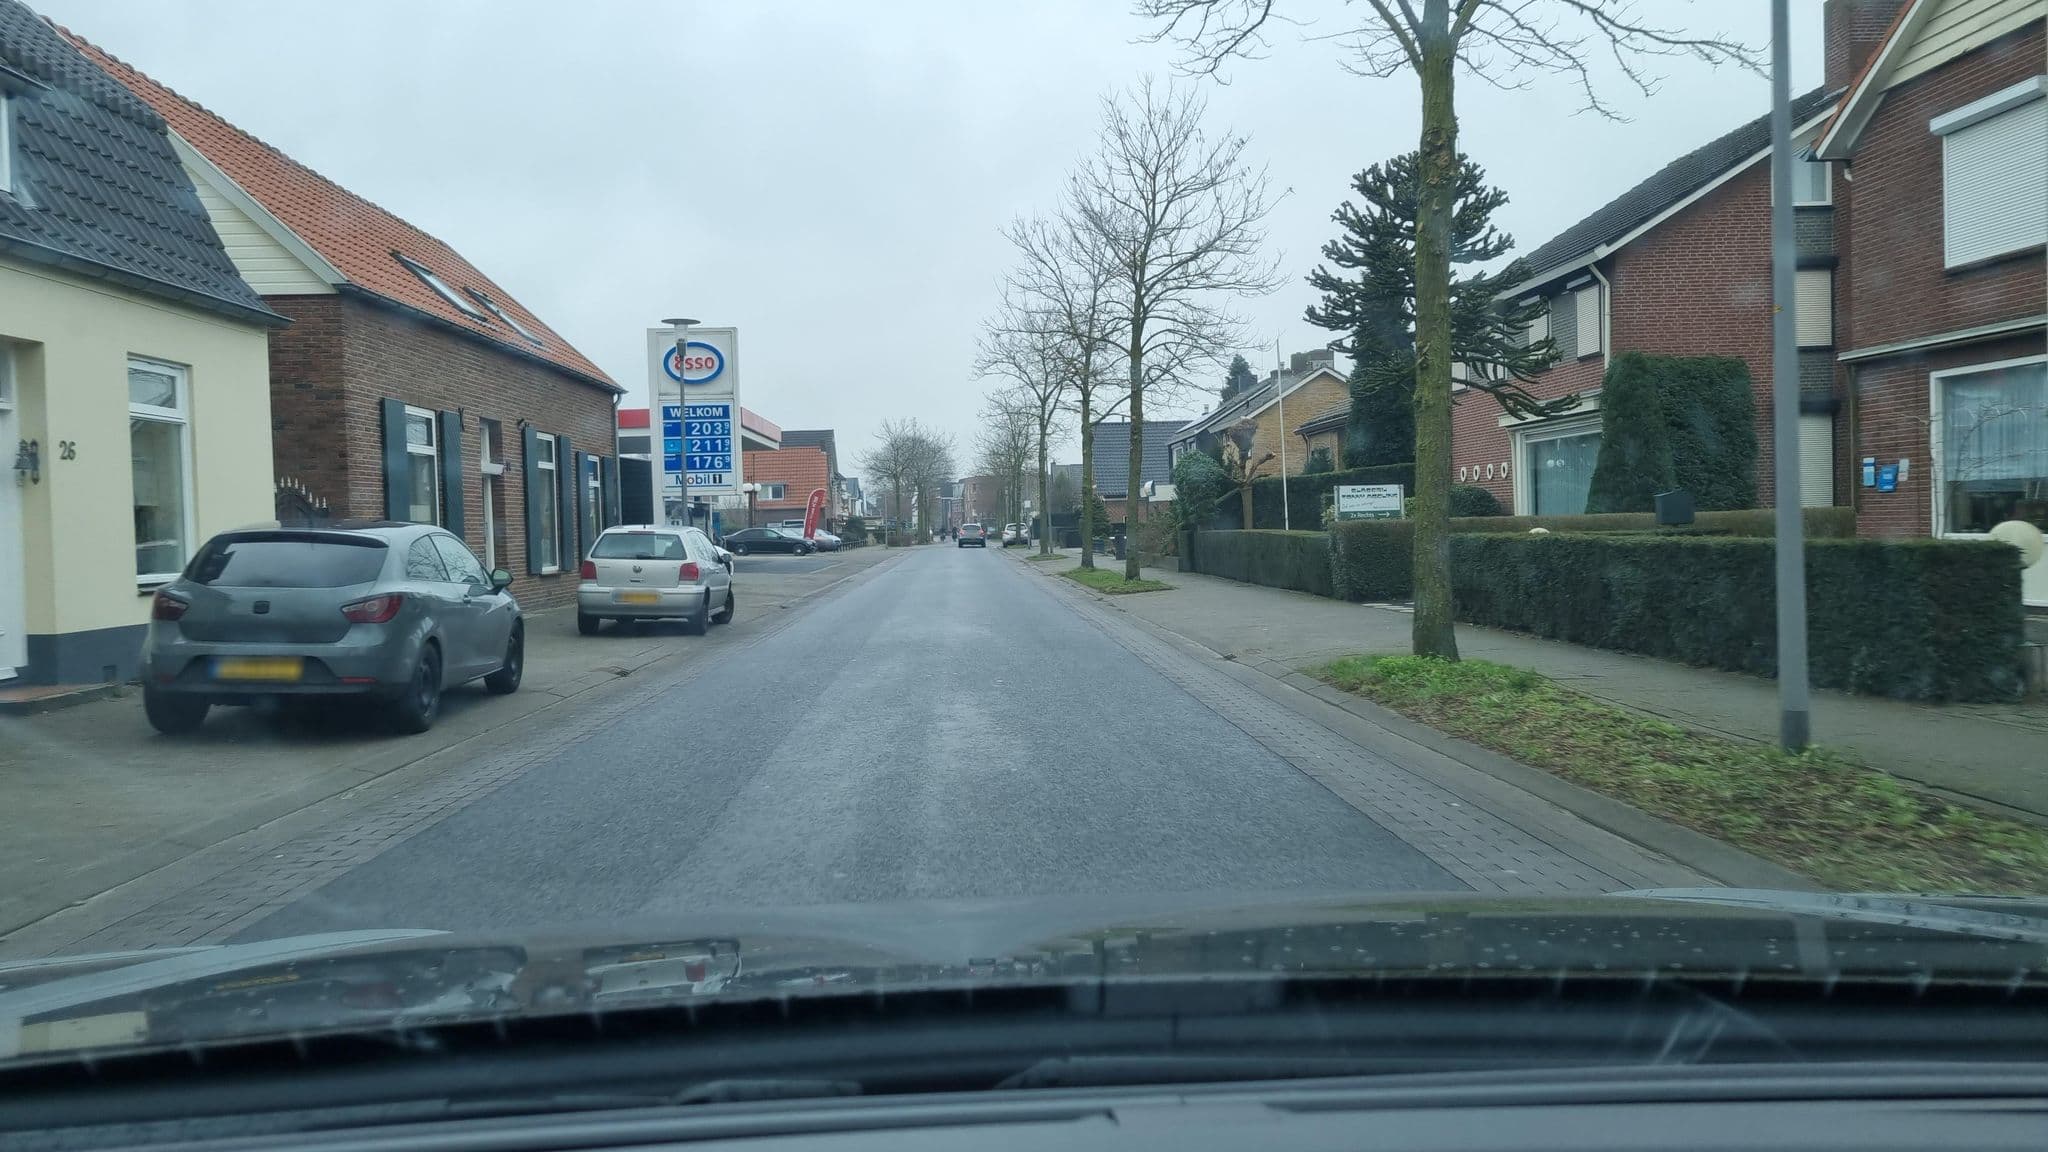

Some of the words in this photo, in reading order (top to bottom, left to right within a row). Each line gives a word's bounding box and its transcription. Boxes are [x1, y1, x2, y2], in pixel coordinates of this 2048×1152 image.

[669, 407, 723, 418] WELKOM
[59, 440, 77, 461] 26
[675, 474, 711, 485] Mobil
